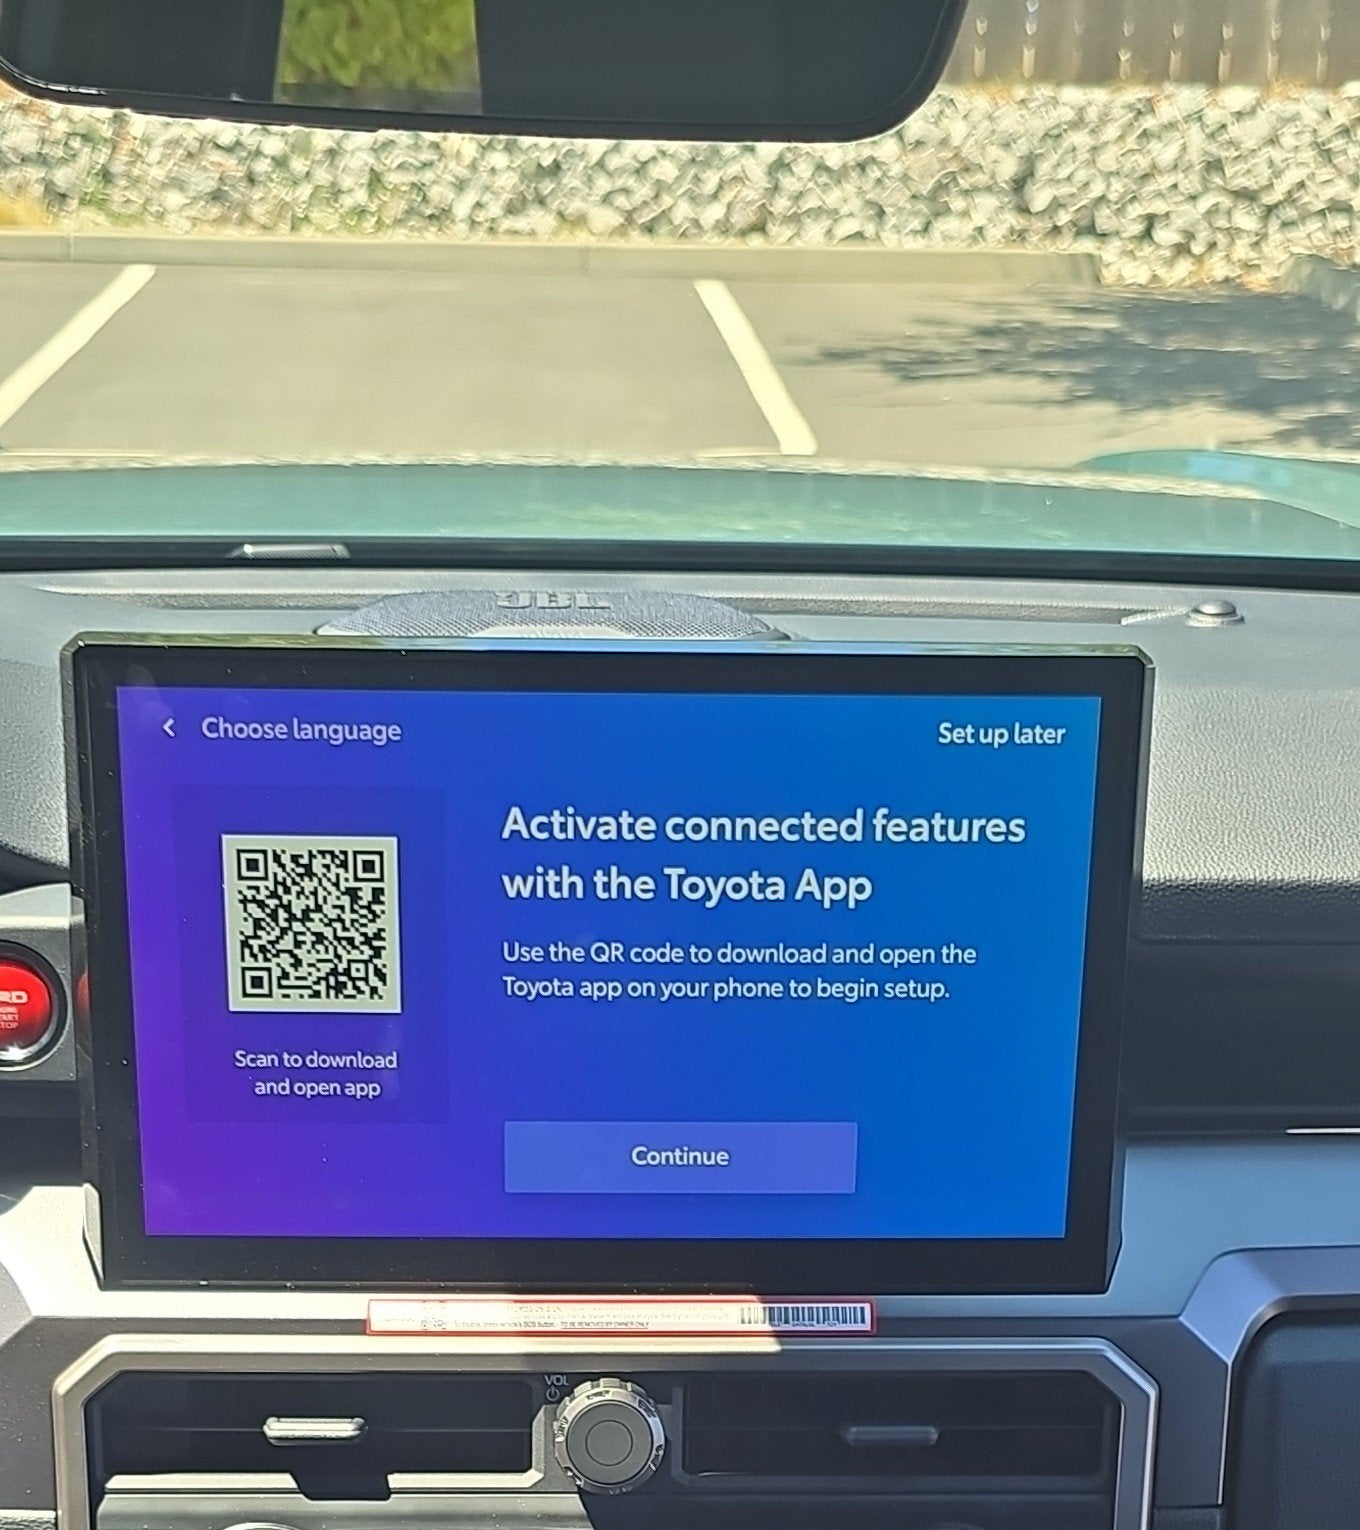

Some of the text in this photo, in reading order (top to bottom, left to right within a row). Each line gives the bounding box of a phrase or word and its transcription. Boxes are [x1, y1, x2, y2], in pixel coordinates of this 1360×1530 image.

[201, 716, 403, 746] Choose language
[938, 722, 1066, 749] Set up later
[501, 806, 1026, 843] Activate connected features
[501, 864, 873, 909] with the Toyota App
[503, 940, 977, 968] Use the QR code to download and open the
[501, 975, 950, 1003] Toyota app on your phone to begin setup.
[234, 1050, 398, 1069] Scan to download
[254, 1078, 381, 1100] and open app
[631, 1146, 730, 1166] Continue
[544, 1375, 569, 1386] VOL
